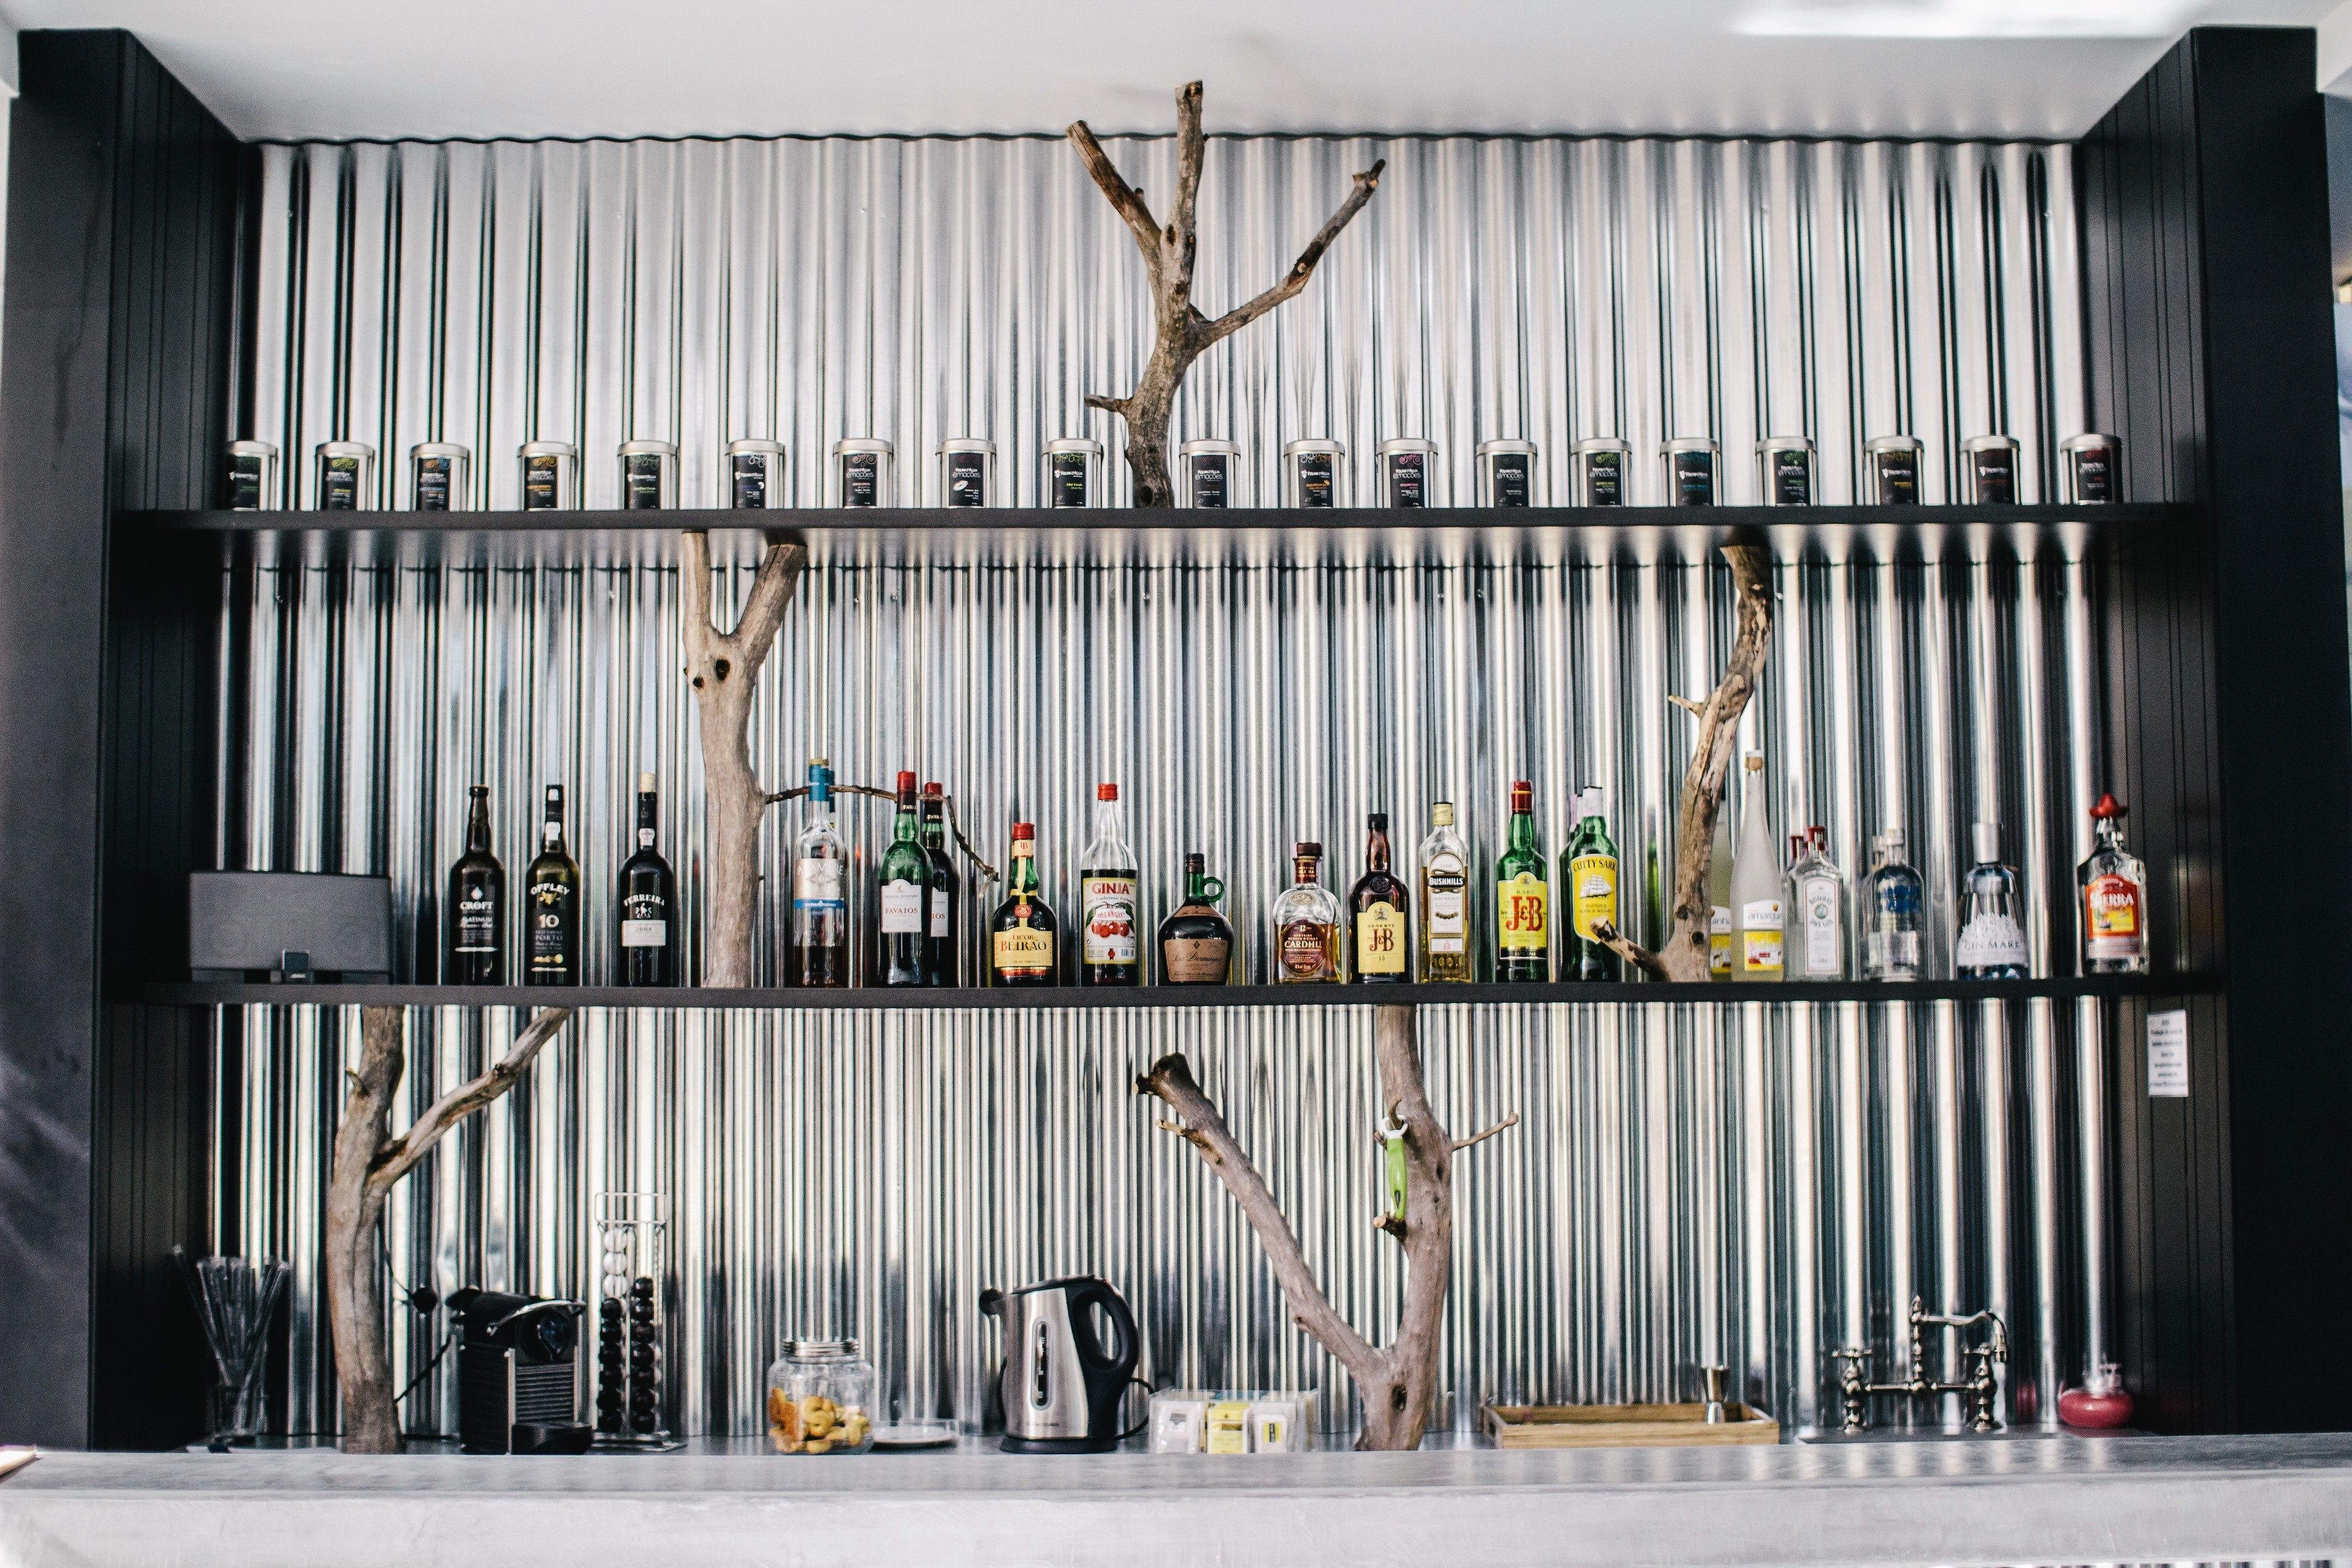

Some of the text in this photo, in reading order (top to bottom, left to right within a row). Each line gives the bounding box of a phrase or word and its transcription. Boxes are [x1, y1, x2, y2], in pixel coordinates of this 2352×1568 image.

[1572, 859, 1616, 872] CUTTY SARK
[1429, 877, 1464, 886] BUSHMILLS
[530, 883, 570, 895] OFFLEY
[1092, 882, 1130, 895] GINJA
[459, 901, 494, 910] CROFT
[624, 894, 665, 907] FERREIRA
[2089, 892, 2135, 910] SIERRA
[1506, 895, 1543, 931] J&B
[539, 913, 560, 929] 10
[1369, 928, 1395, 952] J&B
[1964, 938, 2019, 951] GIN MARE
